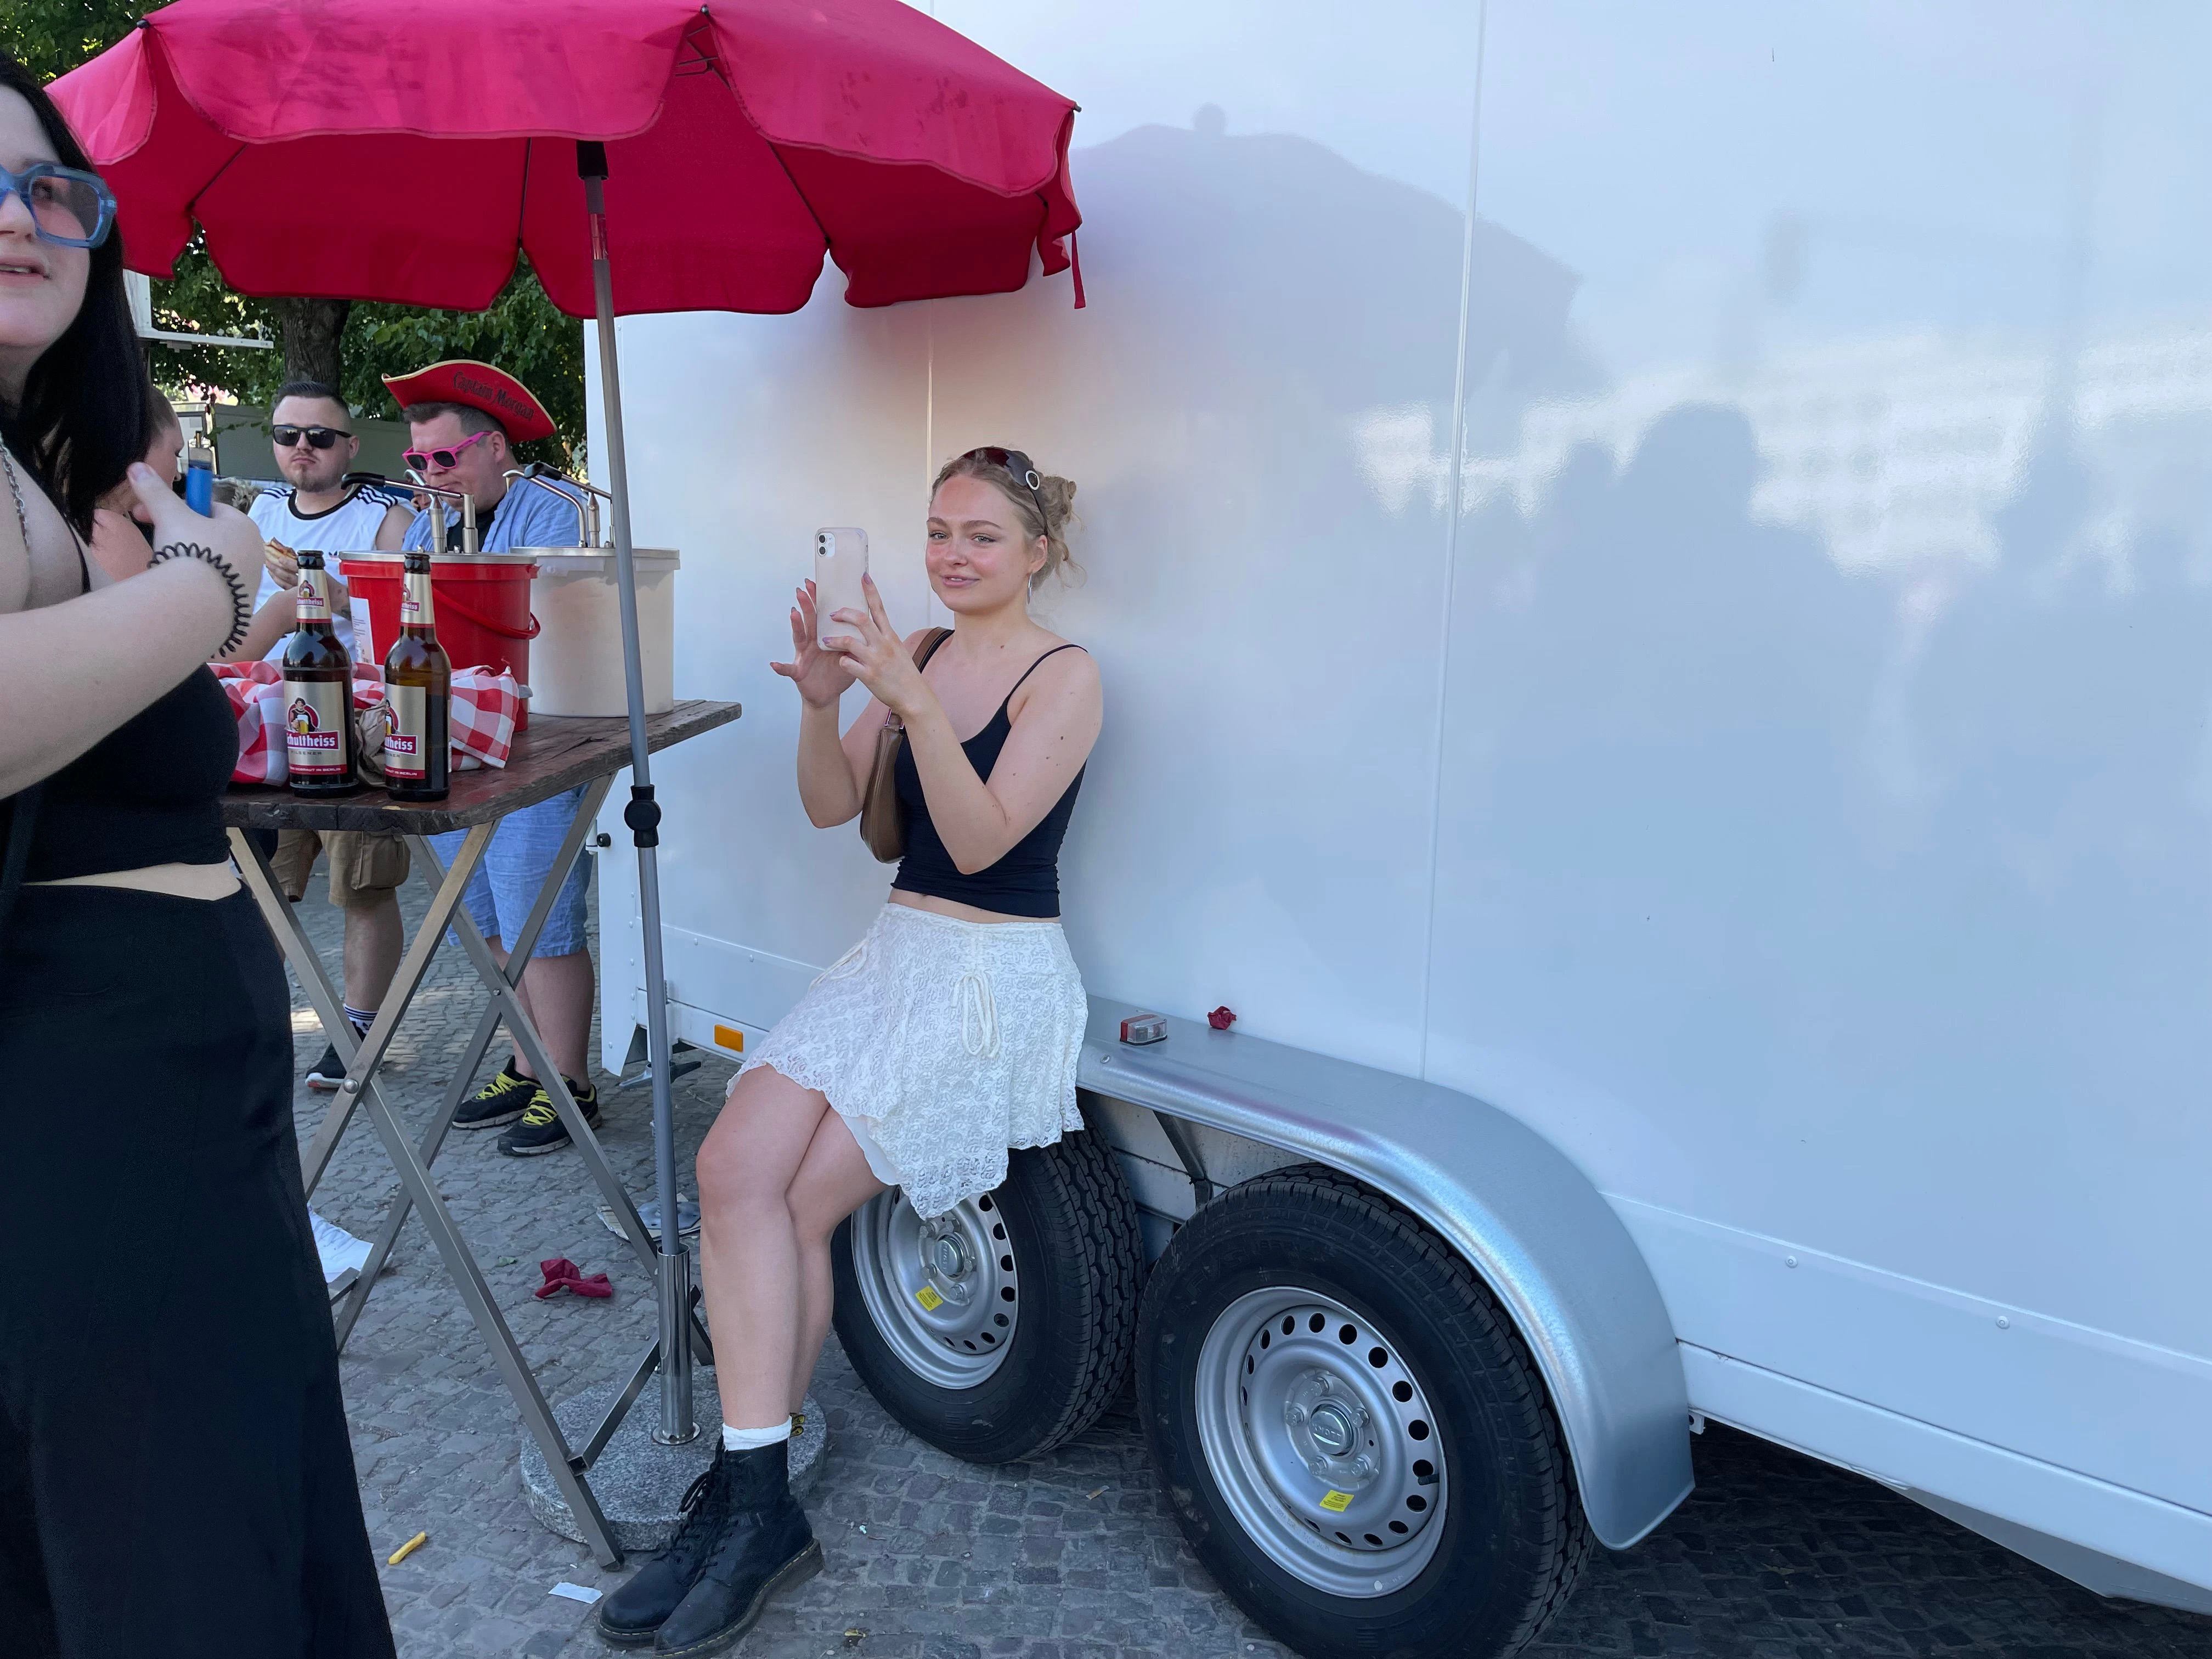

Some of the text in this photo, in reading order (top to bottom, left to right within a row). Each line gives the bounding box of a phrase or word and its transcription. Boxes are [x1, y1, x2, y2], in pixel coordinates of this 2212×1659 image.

[453, 371, 535, 421] Captain Morgan
[286, 732, 335, 747] chultheiss
